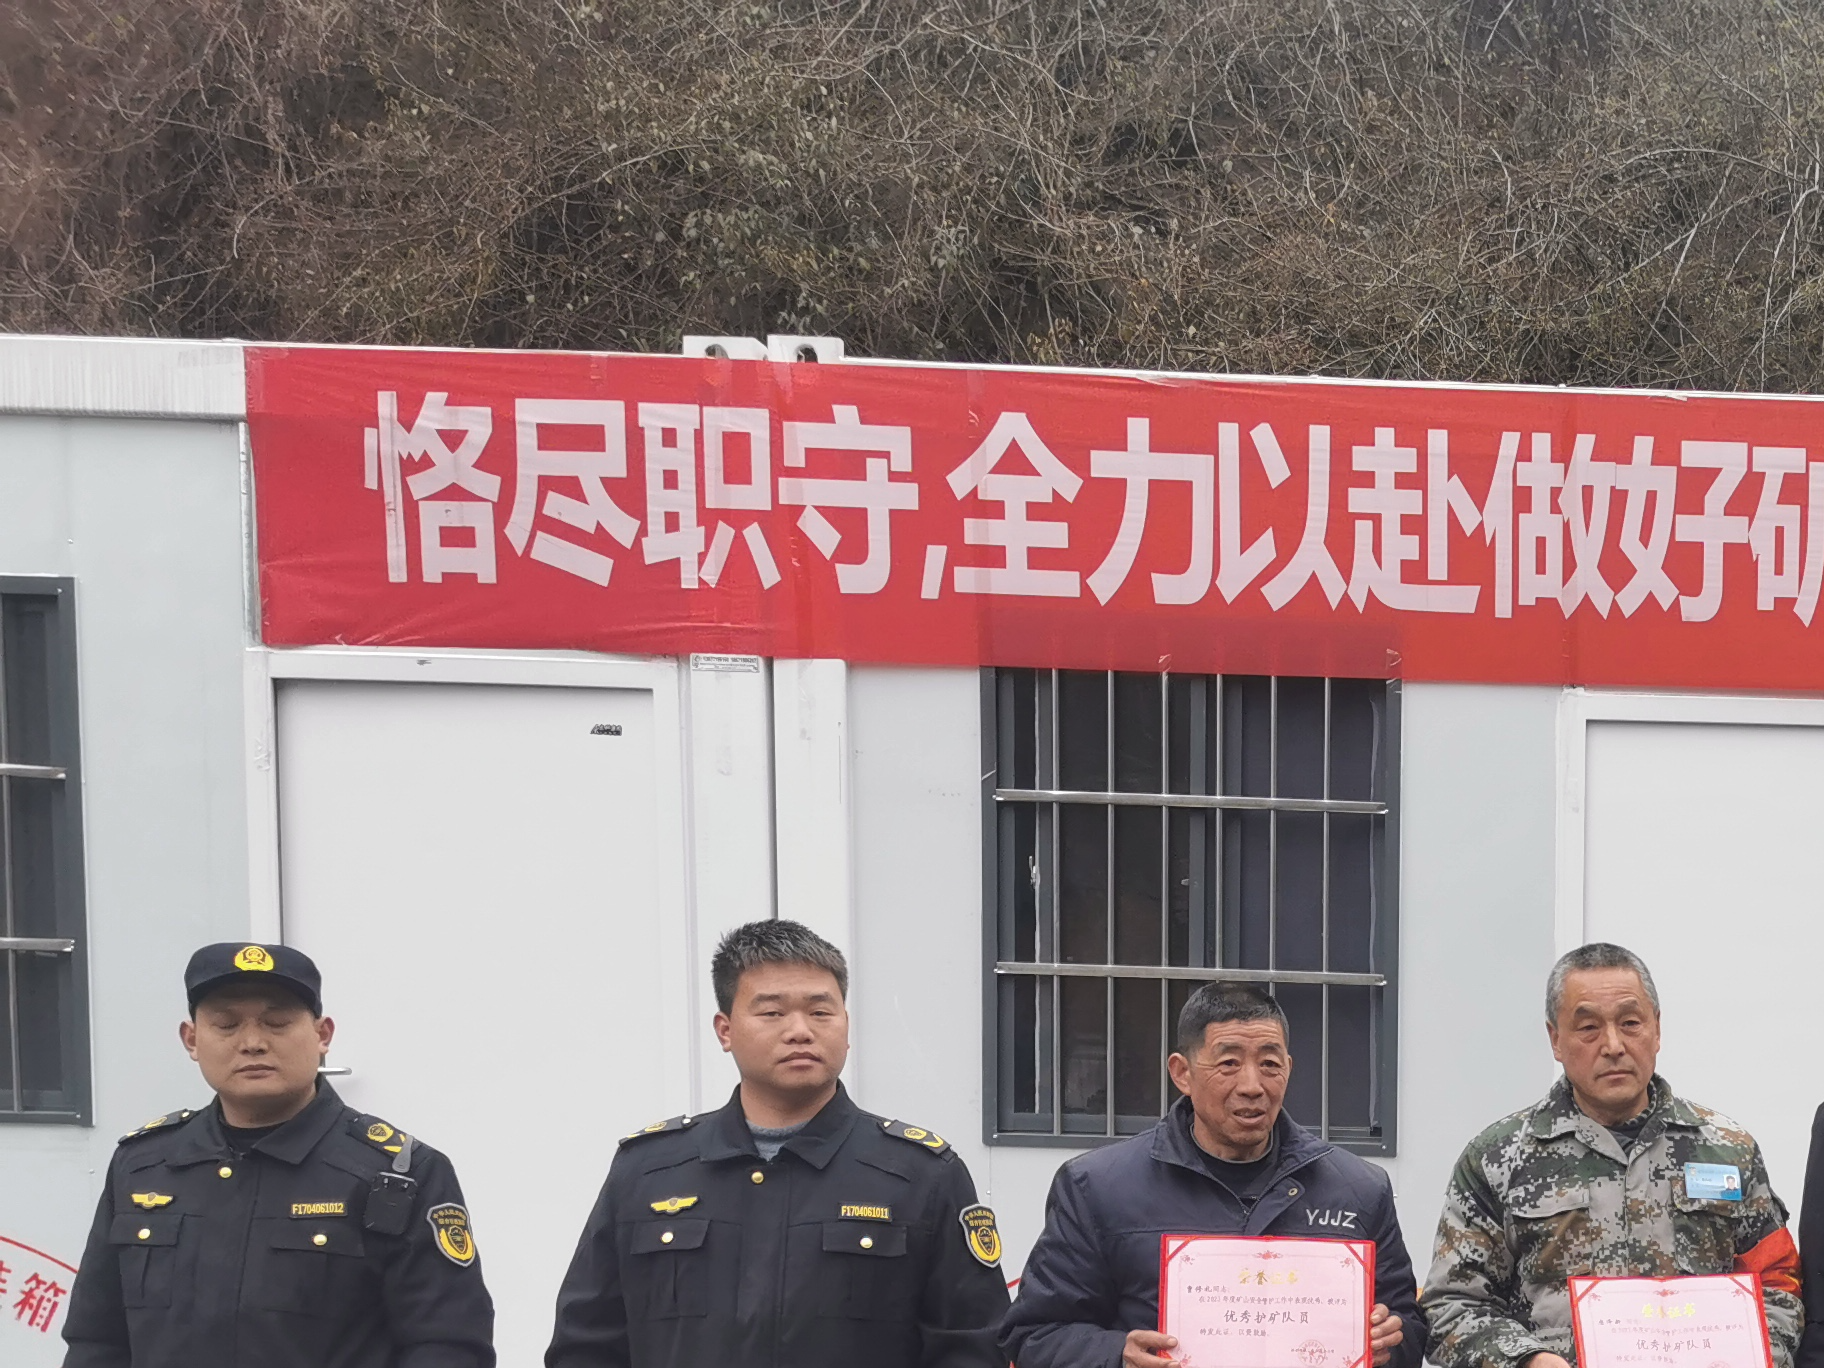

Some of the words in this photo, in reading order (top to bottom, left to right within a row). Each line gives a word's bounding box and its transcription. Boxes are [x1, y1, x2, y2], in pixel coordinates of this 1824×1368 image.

[1306, 1209, 1357, 1228] YJJZ
[1223, 1310, 1310, 1324] 优秀护矿队员
